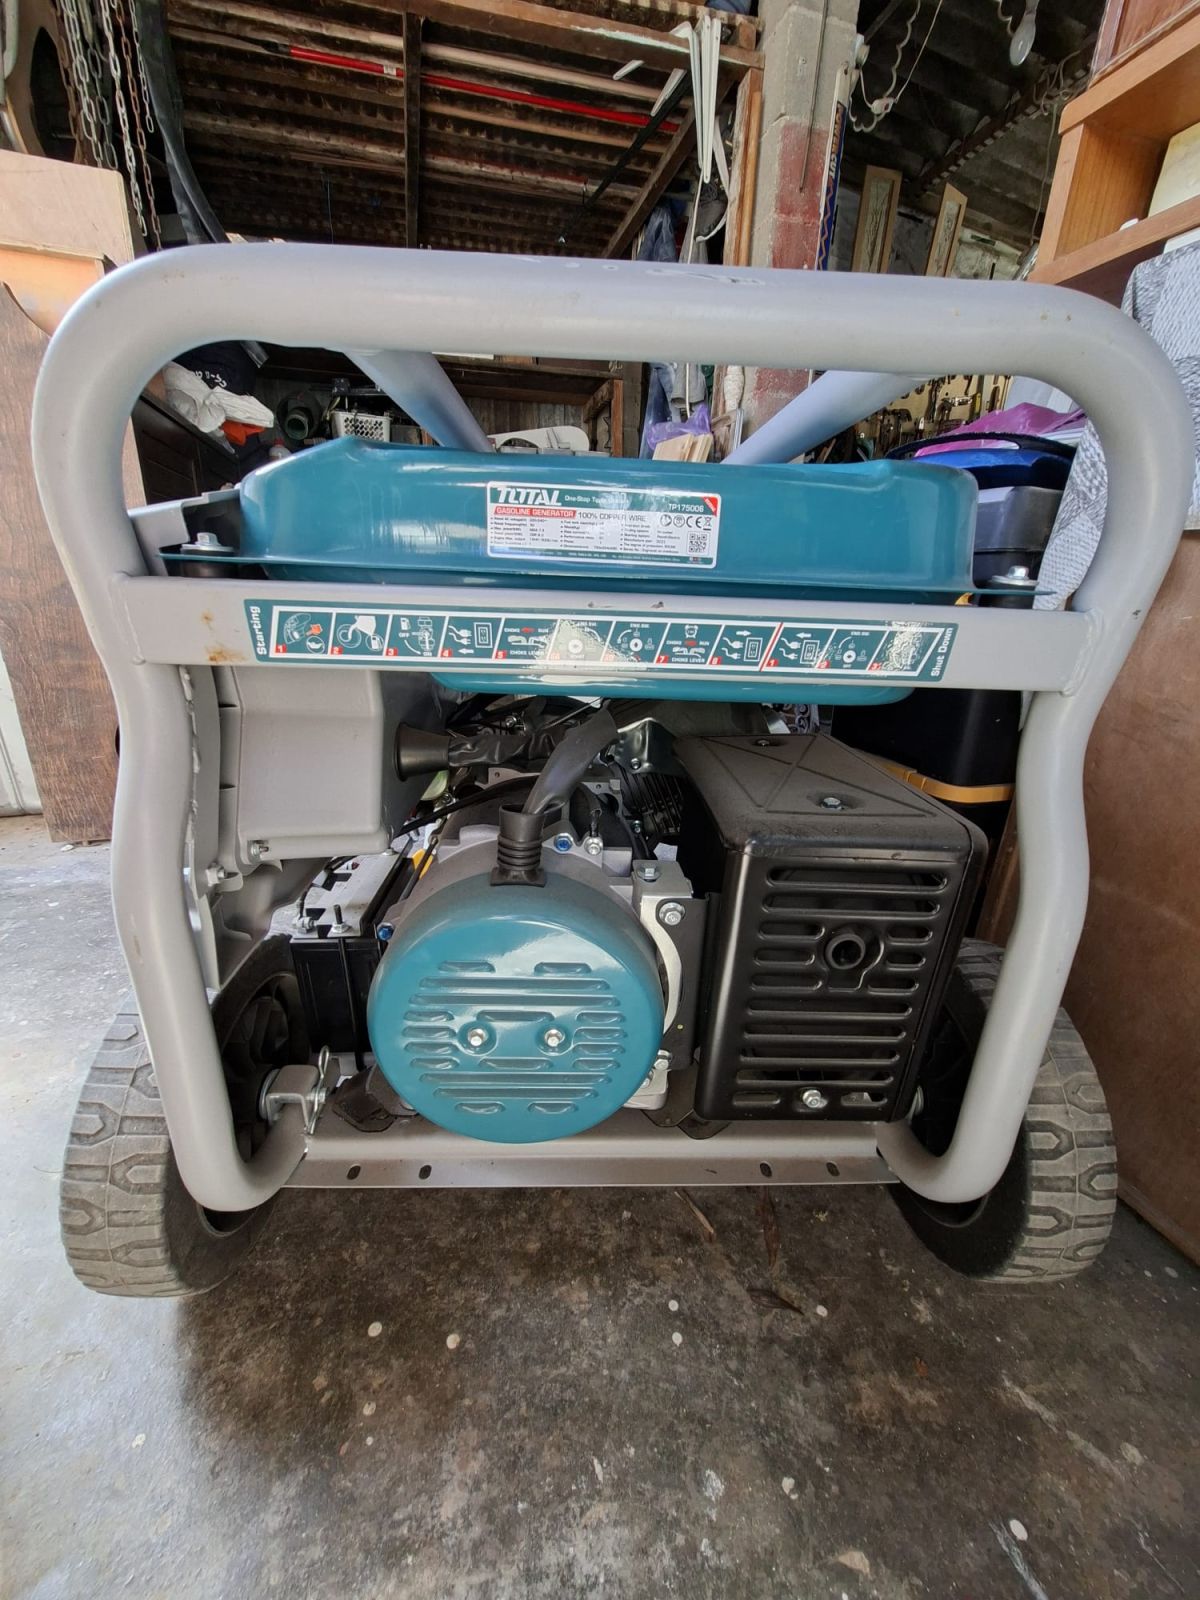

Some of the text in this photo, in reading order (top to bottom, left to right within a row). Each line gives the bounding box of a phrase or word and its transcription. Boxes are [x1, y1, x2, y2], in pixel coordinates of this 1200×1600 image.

[829, 154, 837, 179] CUT
[497, 487, 562, 506] TOTAL
[495, 506, 574, 517] GASOLINE GENERATOR
[578, 511, 646, 522] 100% COPPER WIRE
[249, 606, 267, 655] Starting
[930, 627, 954, 677] Shut Down
